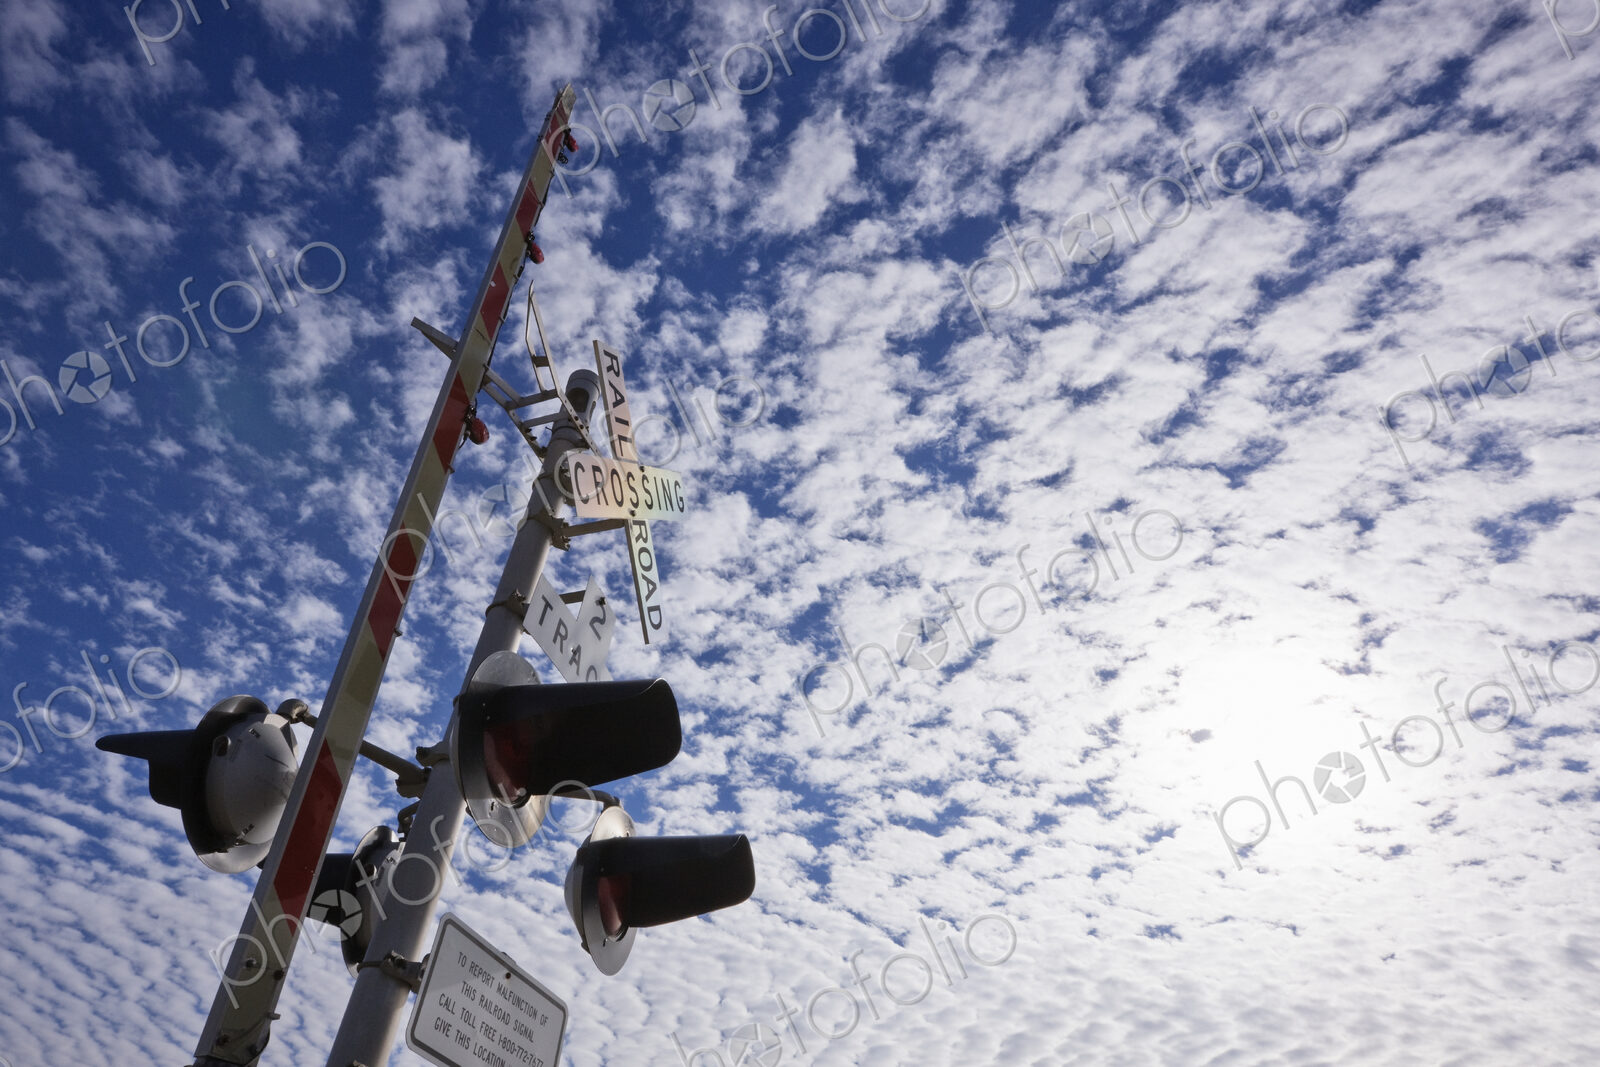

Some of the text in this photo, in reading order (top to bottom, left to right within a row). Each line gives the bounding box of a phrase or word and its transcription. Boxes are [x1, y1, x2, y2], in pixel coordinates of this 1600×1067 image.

[573, 461, 686, 513] CROSSING
[603, 349, 663, 631] RAIL ROAD
[438, 992, 456, 1015] CALL
[460, 1007, 476, 1029] TOLL
[479, 1021, 497, 1042] FREE
[457, 951, 549, 1027] TO REPORT MALFUNCTION OF
[461, 980, 534, 1043] THIS RAILROAD SIGNAL
[434, 1016, 453, 1038] GIVE
[454, 1029, 471, 1050] THIS
